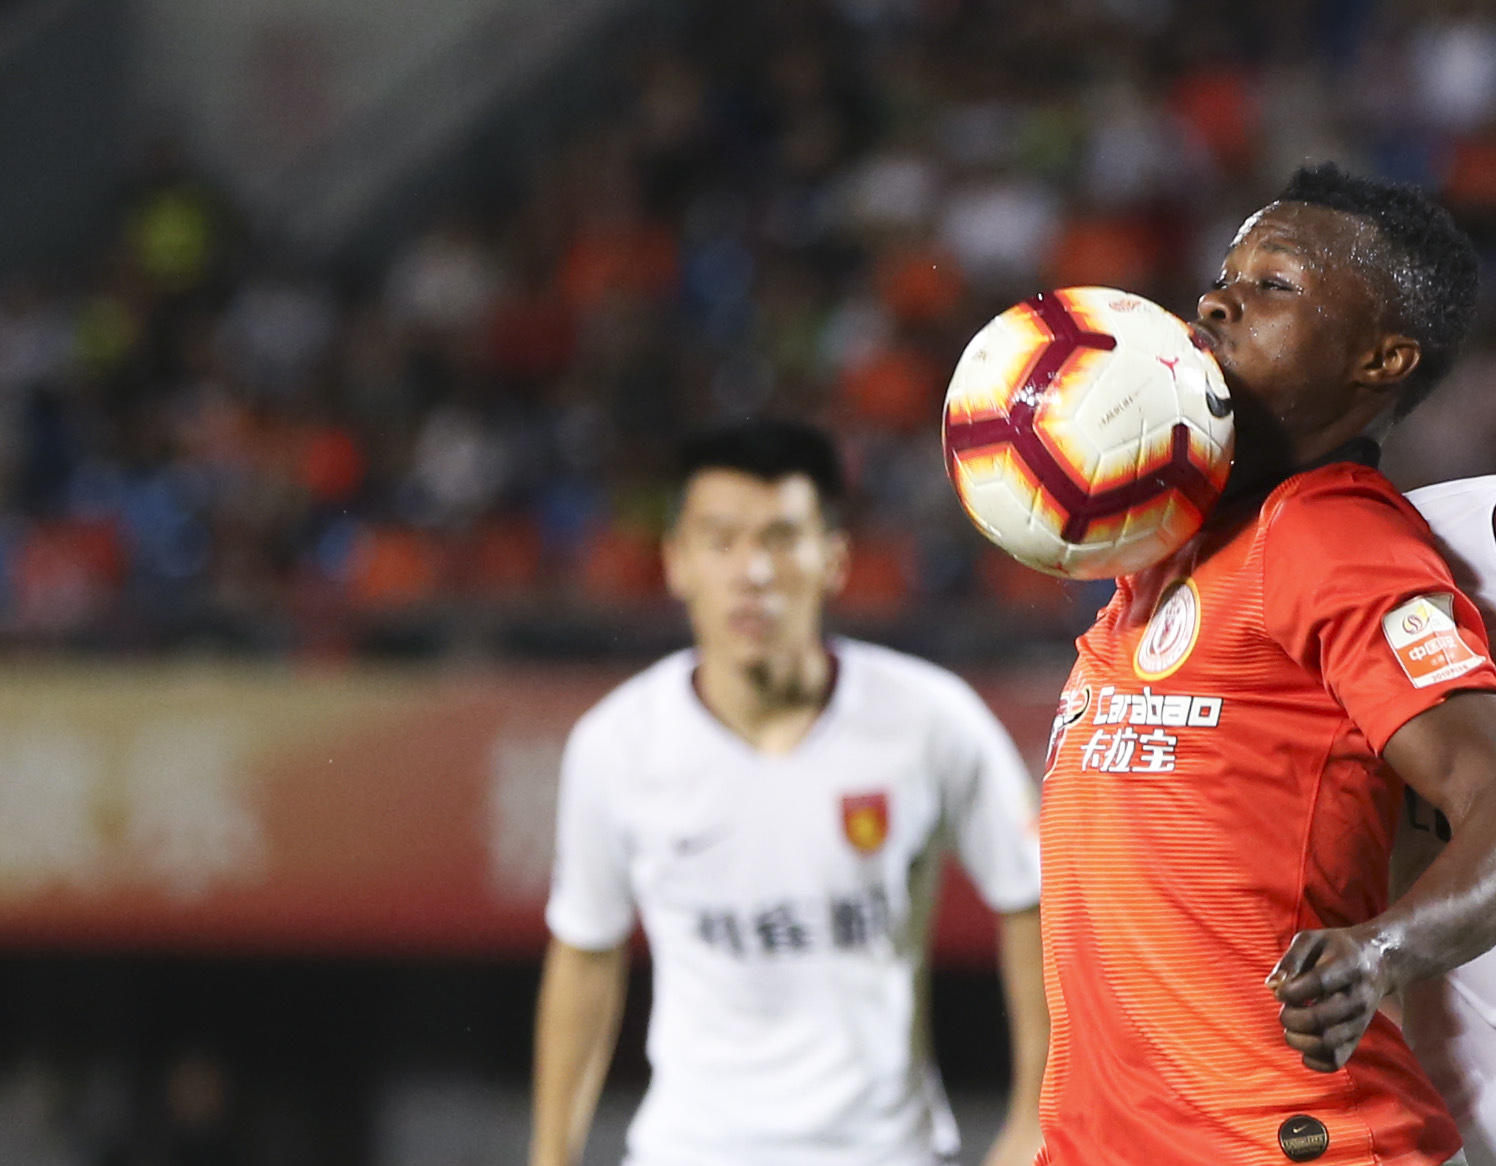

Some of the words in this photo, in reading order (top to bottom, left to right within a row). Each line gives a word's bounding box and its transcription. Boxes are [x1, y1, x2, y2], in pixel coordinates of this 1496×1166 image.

[1093, 686, 1224, 727] Carabao
[1081, 727, 1178, 773] 卡拉宝
